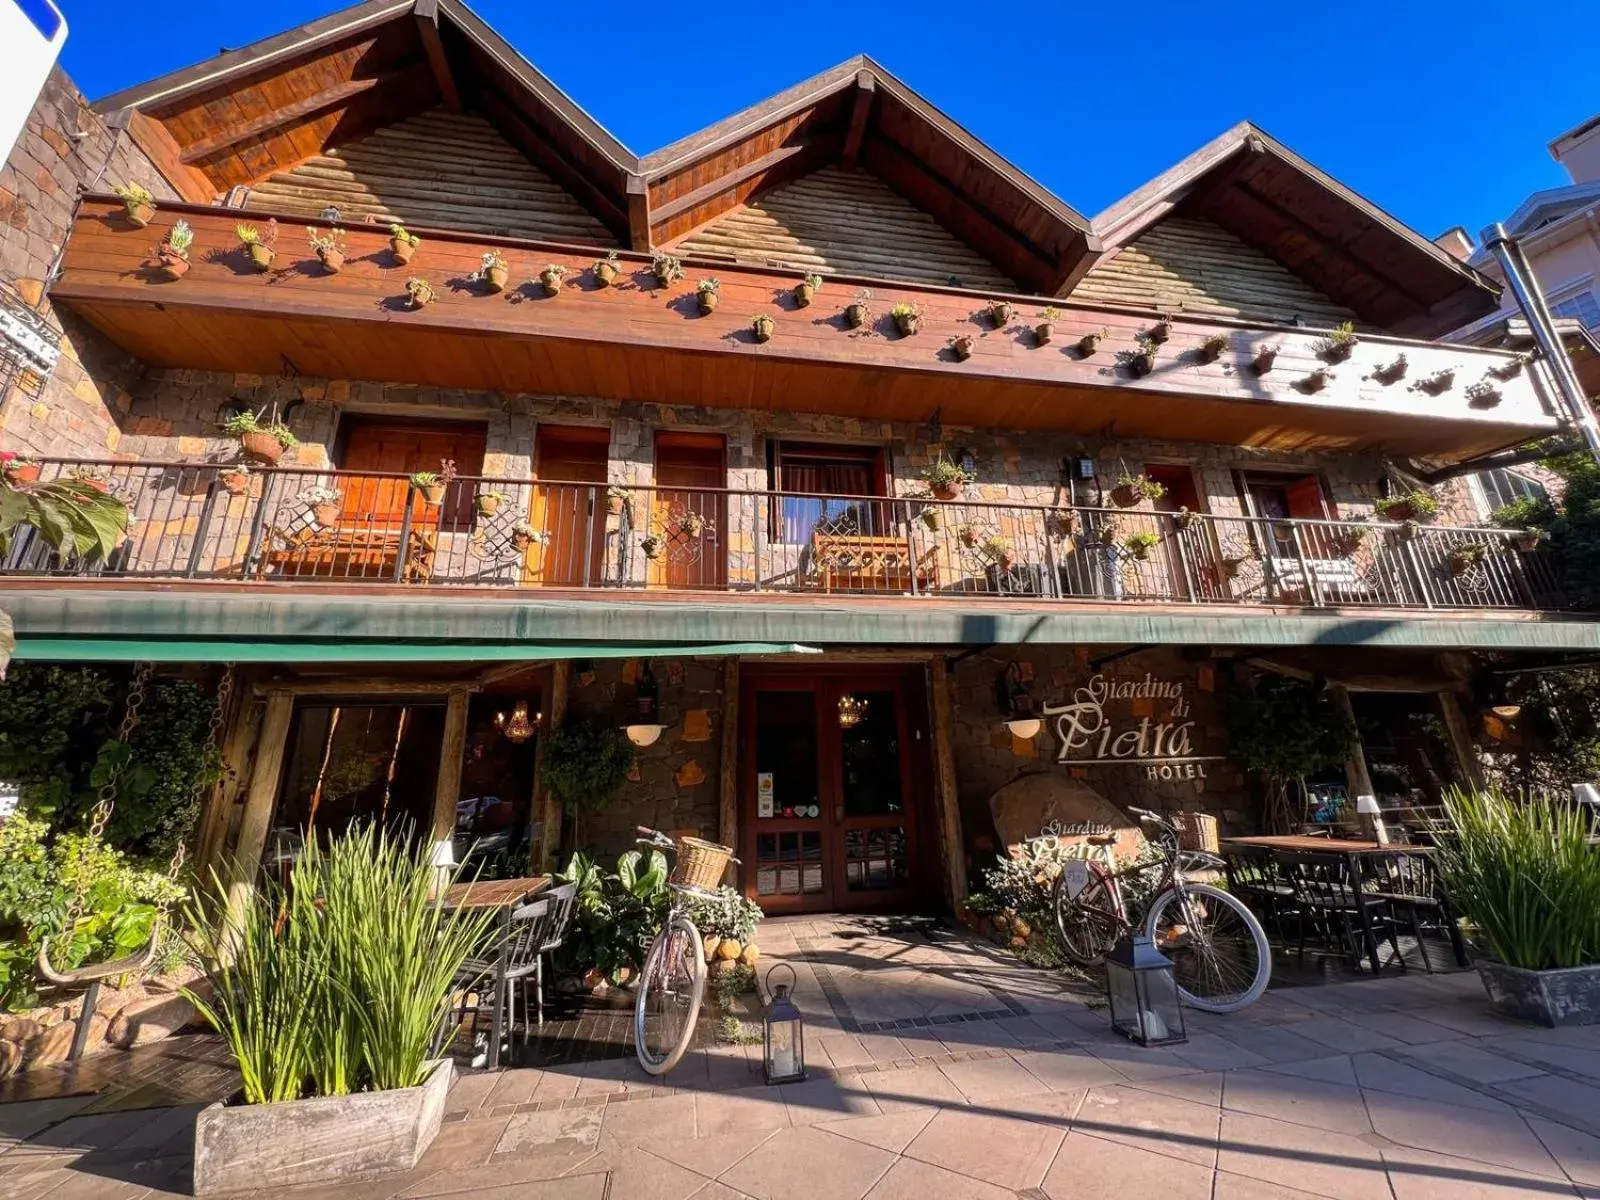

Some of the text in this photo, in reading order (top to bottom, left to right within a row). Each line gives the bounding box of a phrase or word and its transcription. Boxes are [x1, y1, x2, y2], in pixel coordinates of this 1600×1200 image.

[1075, 673, 1183, 706] Giardino
[1171, 696, 1190, 718] di
[1043, 701, 1195, 759] Pietra
[1147, 764, 1208, 782] HOTEL
[1041, 818, 1112, 837] Giardino
